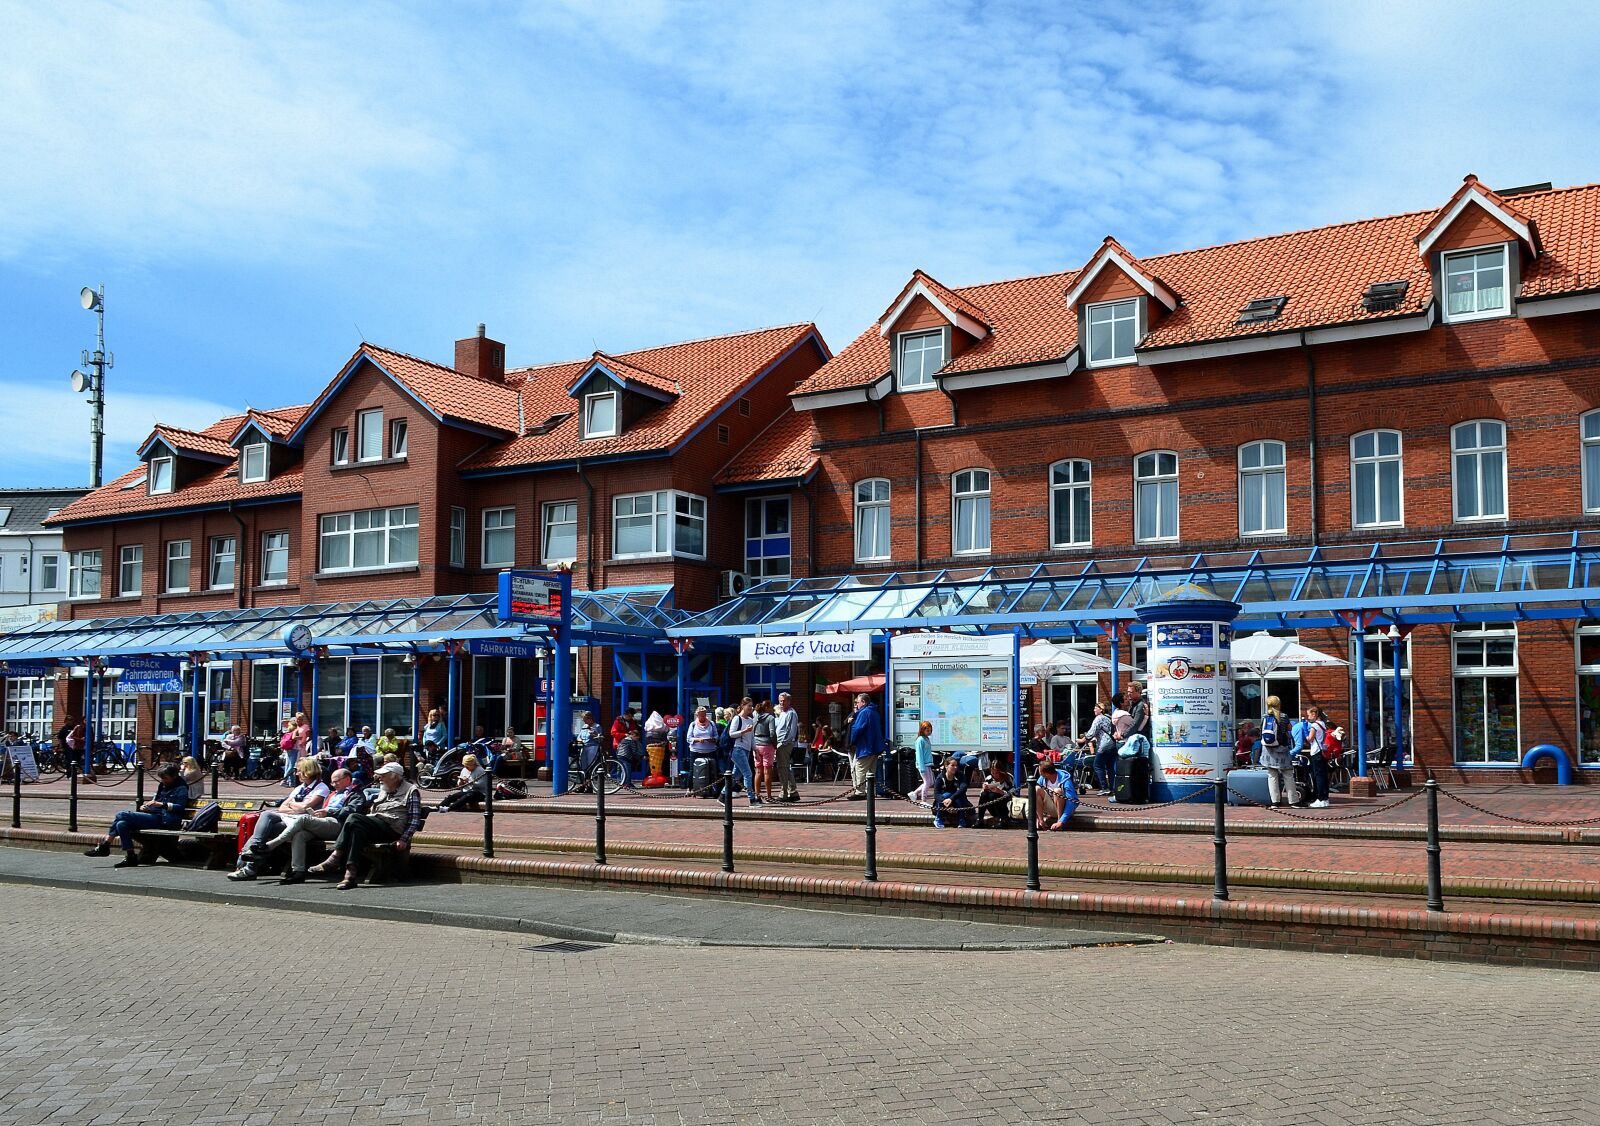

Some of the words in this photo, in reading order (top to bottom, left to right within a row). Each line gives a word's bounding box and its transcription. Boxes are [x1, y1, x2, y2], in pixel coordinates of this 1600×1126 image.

[480, 644, 527, 656] FAHRKARTEN
[754, 642, 804, 656] Eiscafé
[810, 640, 854, 654] Viavai
[130, 659, 160, 668] GEPÄCK
[116, 682, 164, 692] Fietsverhuur
[1158, 688, 1214, 696] Upholm-Hof
